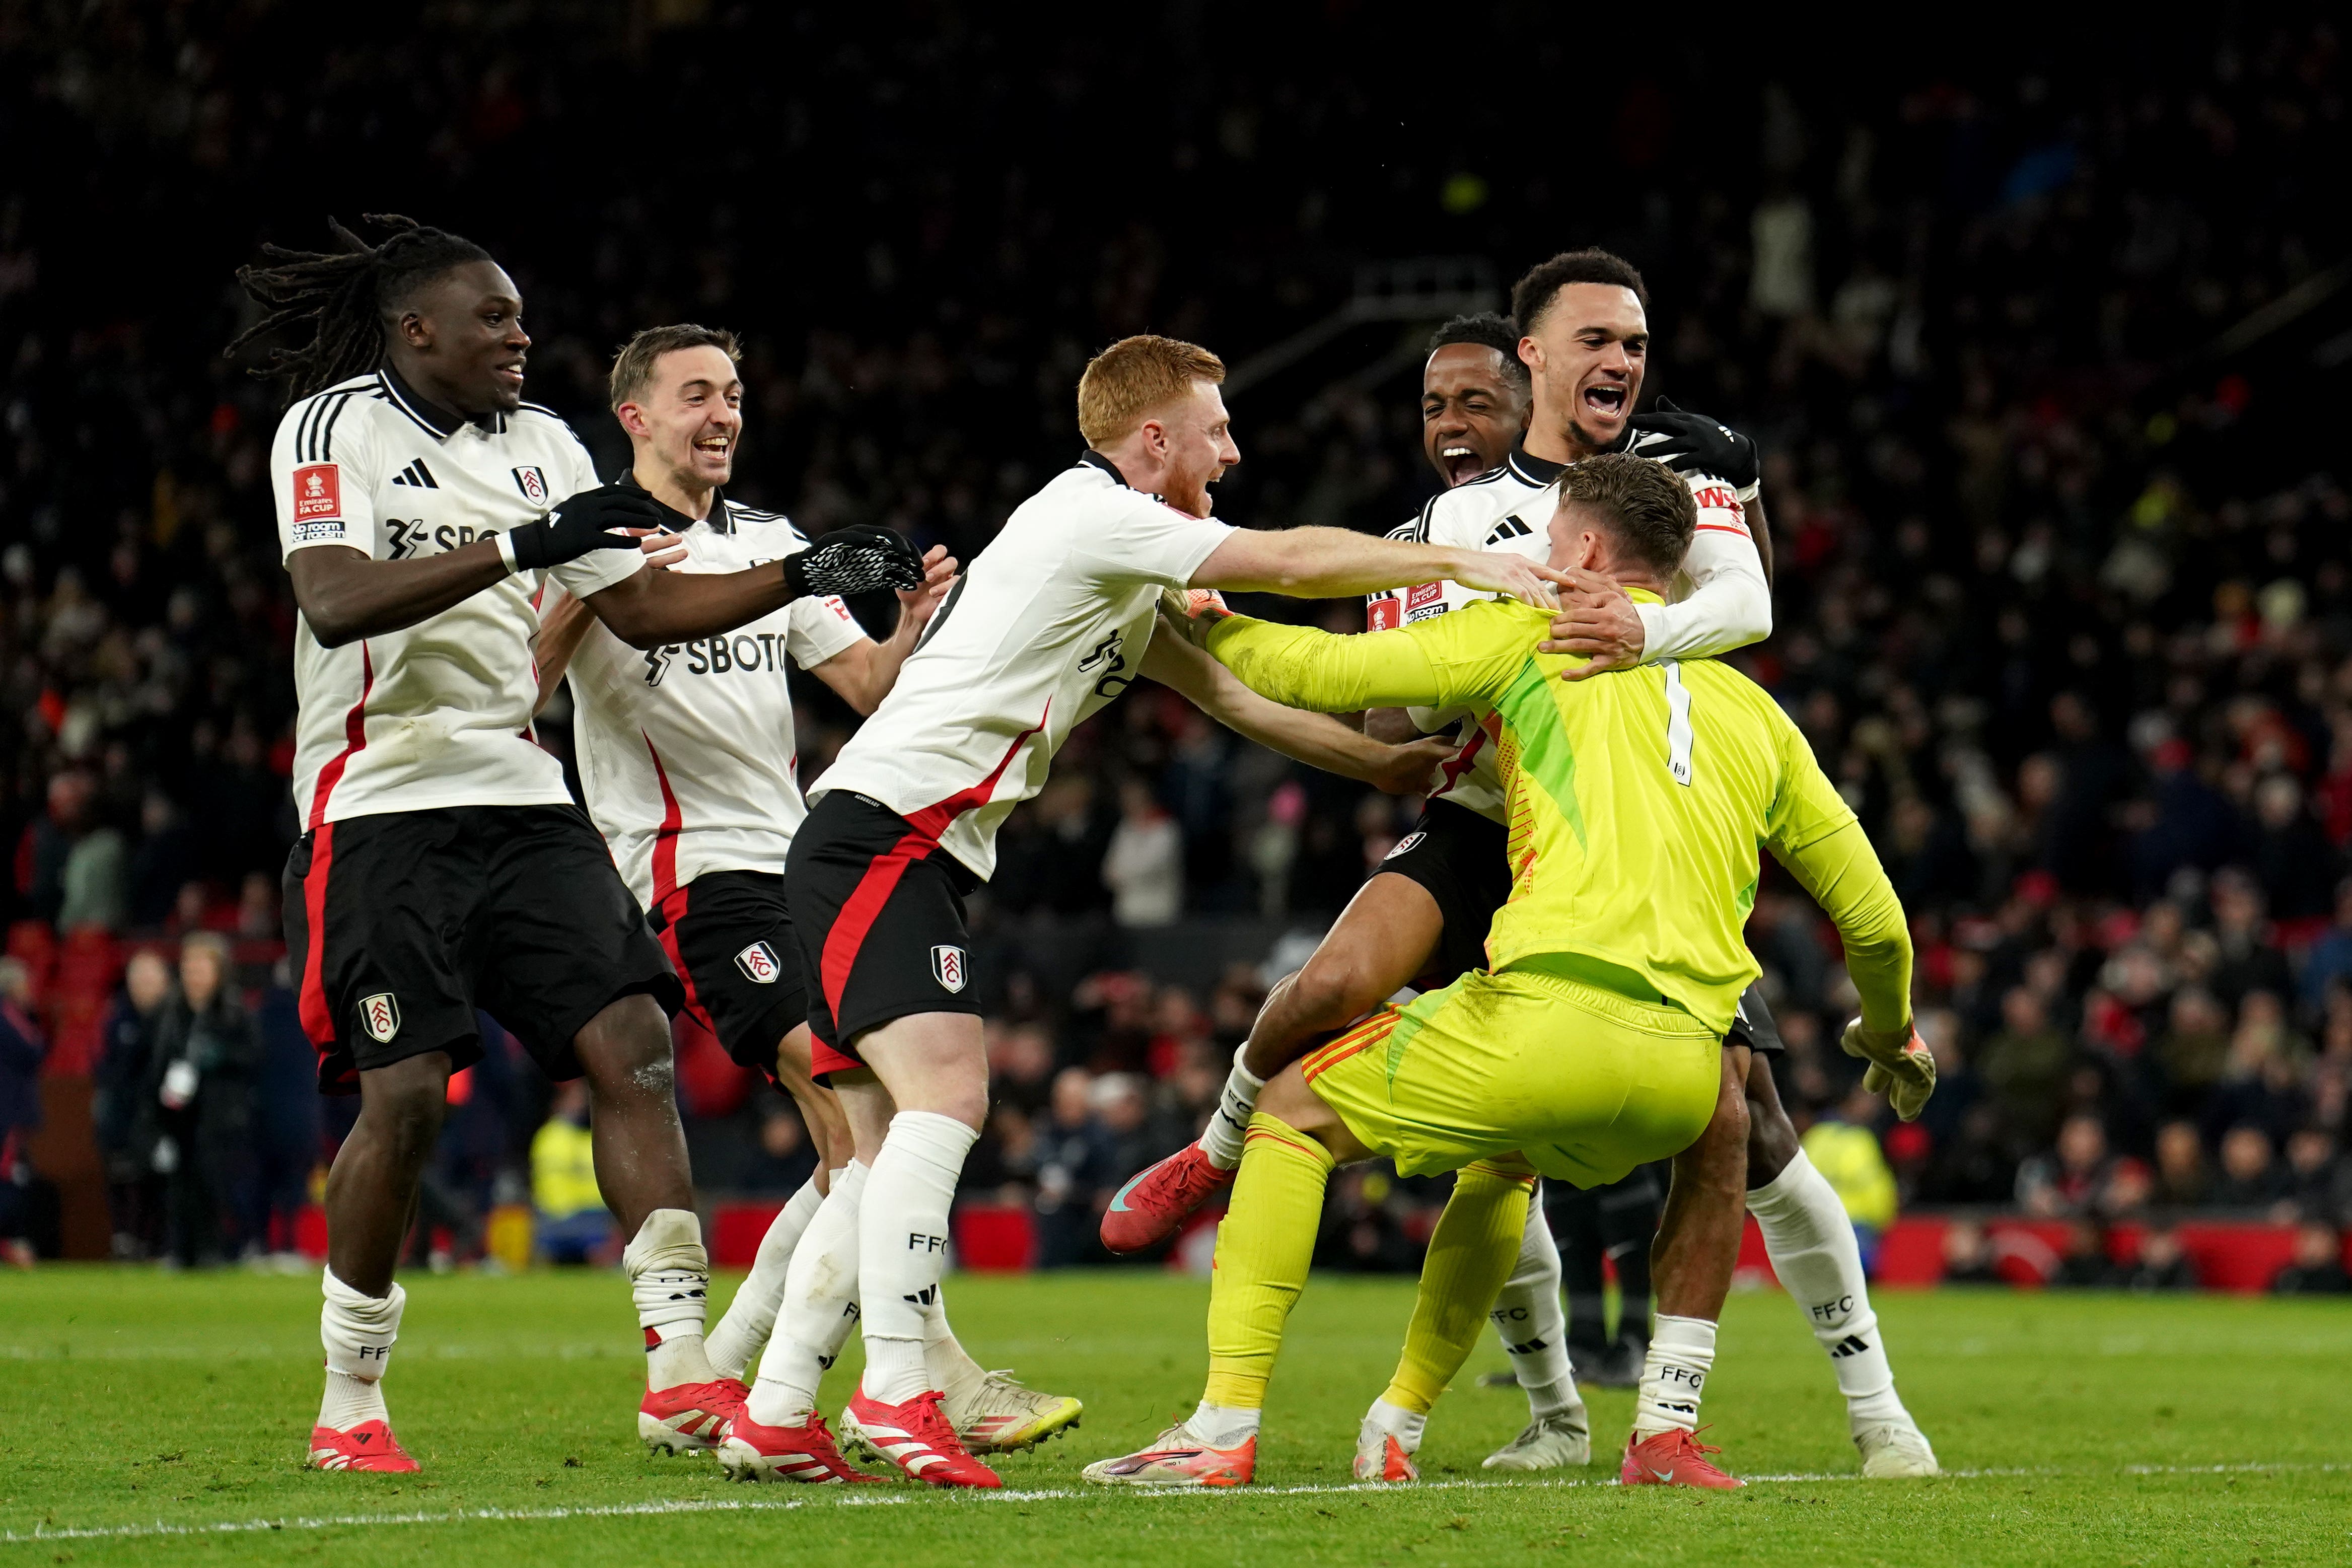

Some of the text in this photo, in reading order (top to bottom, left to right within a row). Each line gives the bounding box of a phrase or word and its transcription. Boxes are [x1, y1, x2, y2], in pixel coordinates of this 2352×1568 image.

[524, 470, 541, 497] FFC
[299, 498, 332, 507] Emirates
[300, 504, 334, 515] FA CUP
[307, 530, 345, 539] racism
[308, 522, 340, 532] room
[1410, 589, 1437, 606] FA CUP
[1411, 583, 1437, 599] Emirates
[1415, 605, 1444, 618] room
[1643, 657, 1694, 787] 1
[749, 951, 771, 976] FFC
[943, 952, 959, 983] FFC
[371, 1001, 390, 1033] FFC
[1229, 1089, 1251, 1113] FC
[1812, 1295, 1854, 1320] FFC
[1661, 1366, 1701, 1388] FFC
